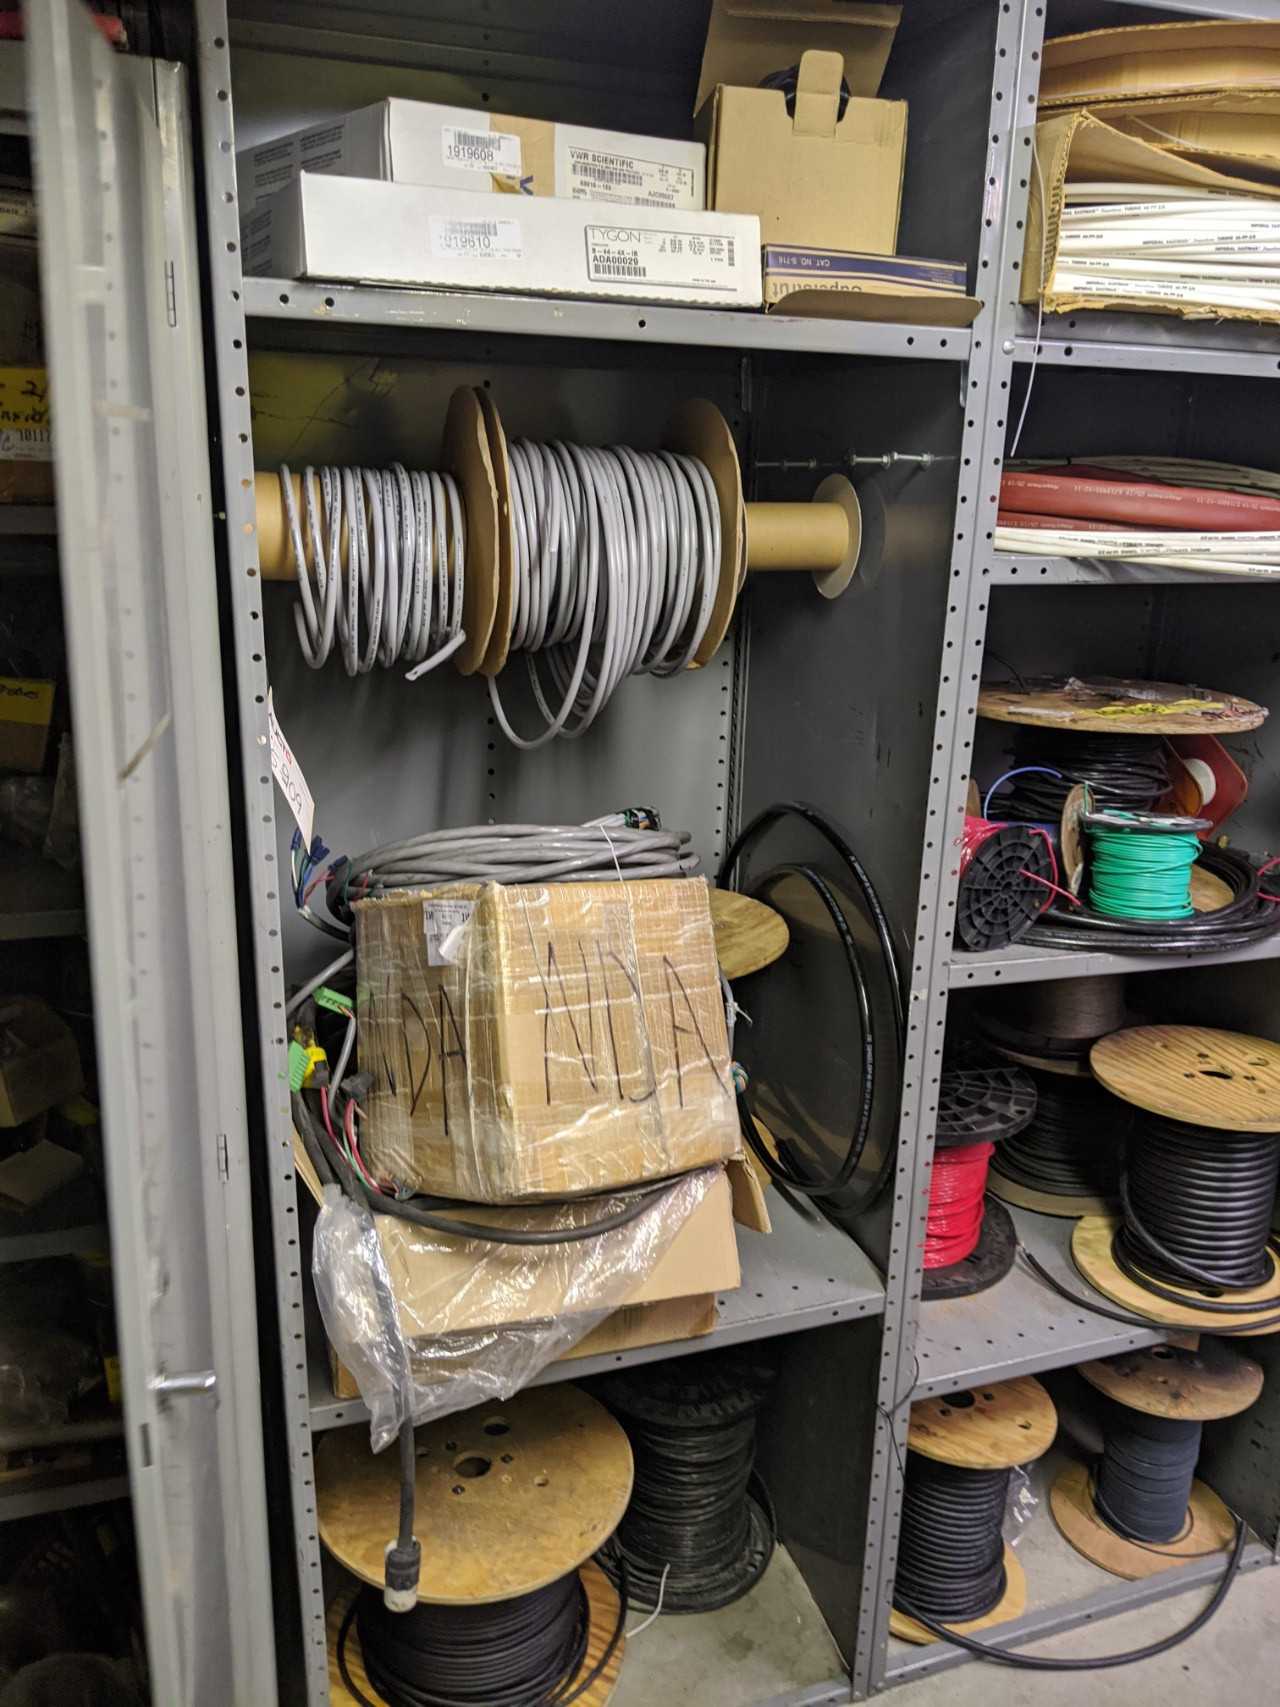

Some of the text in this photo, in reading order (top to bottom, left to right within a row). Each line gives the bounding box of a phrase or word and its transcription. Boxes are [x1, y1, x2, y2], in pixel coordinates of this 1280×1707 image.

[447, 144, 494, 161] 1919608
[570, 149, 589, 161] VWR
[591, 153, 634, 169] SCIENTIFIC
[591, 228, 641, 243] TYGON
